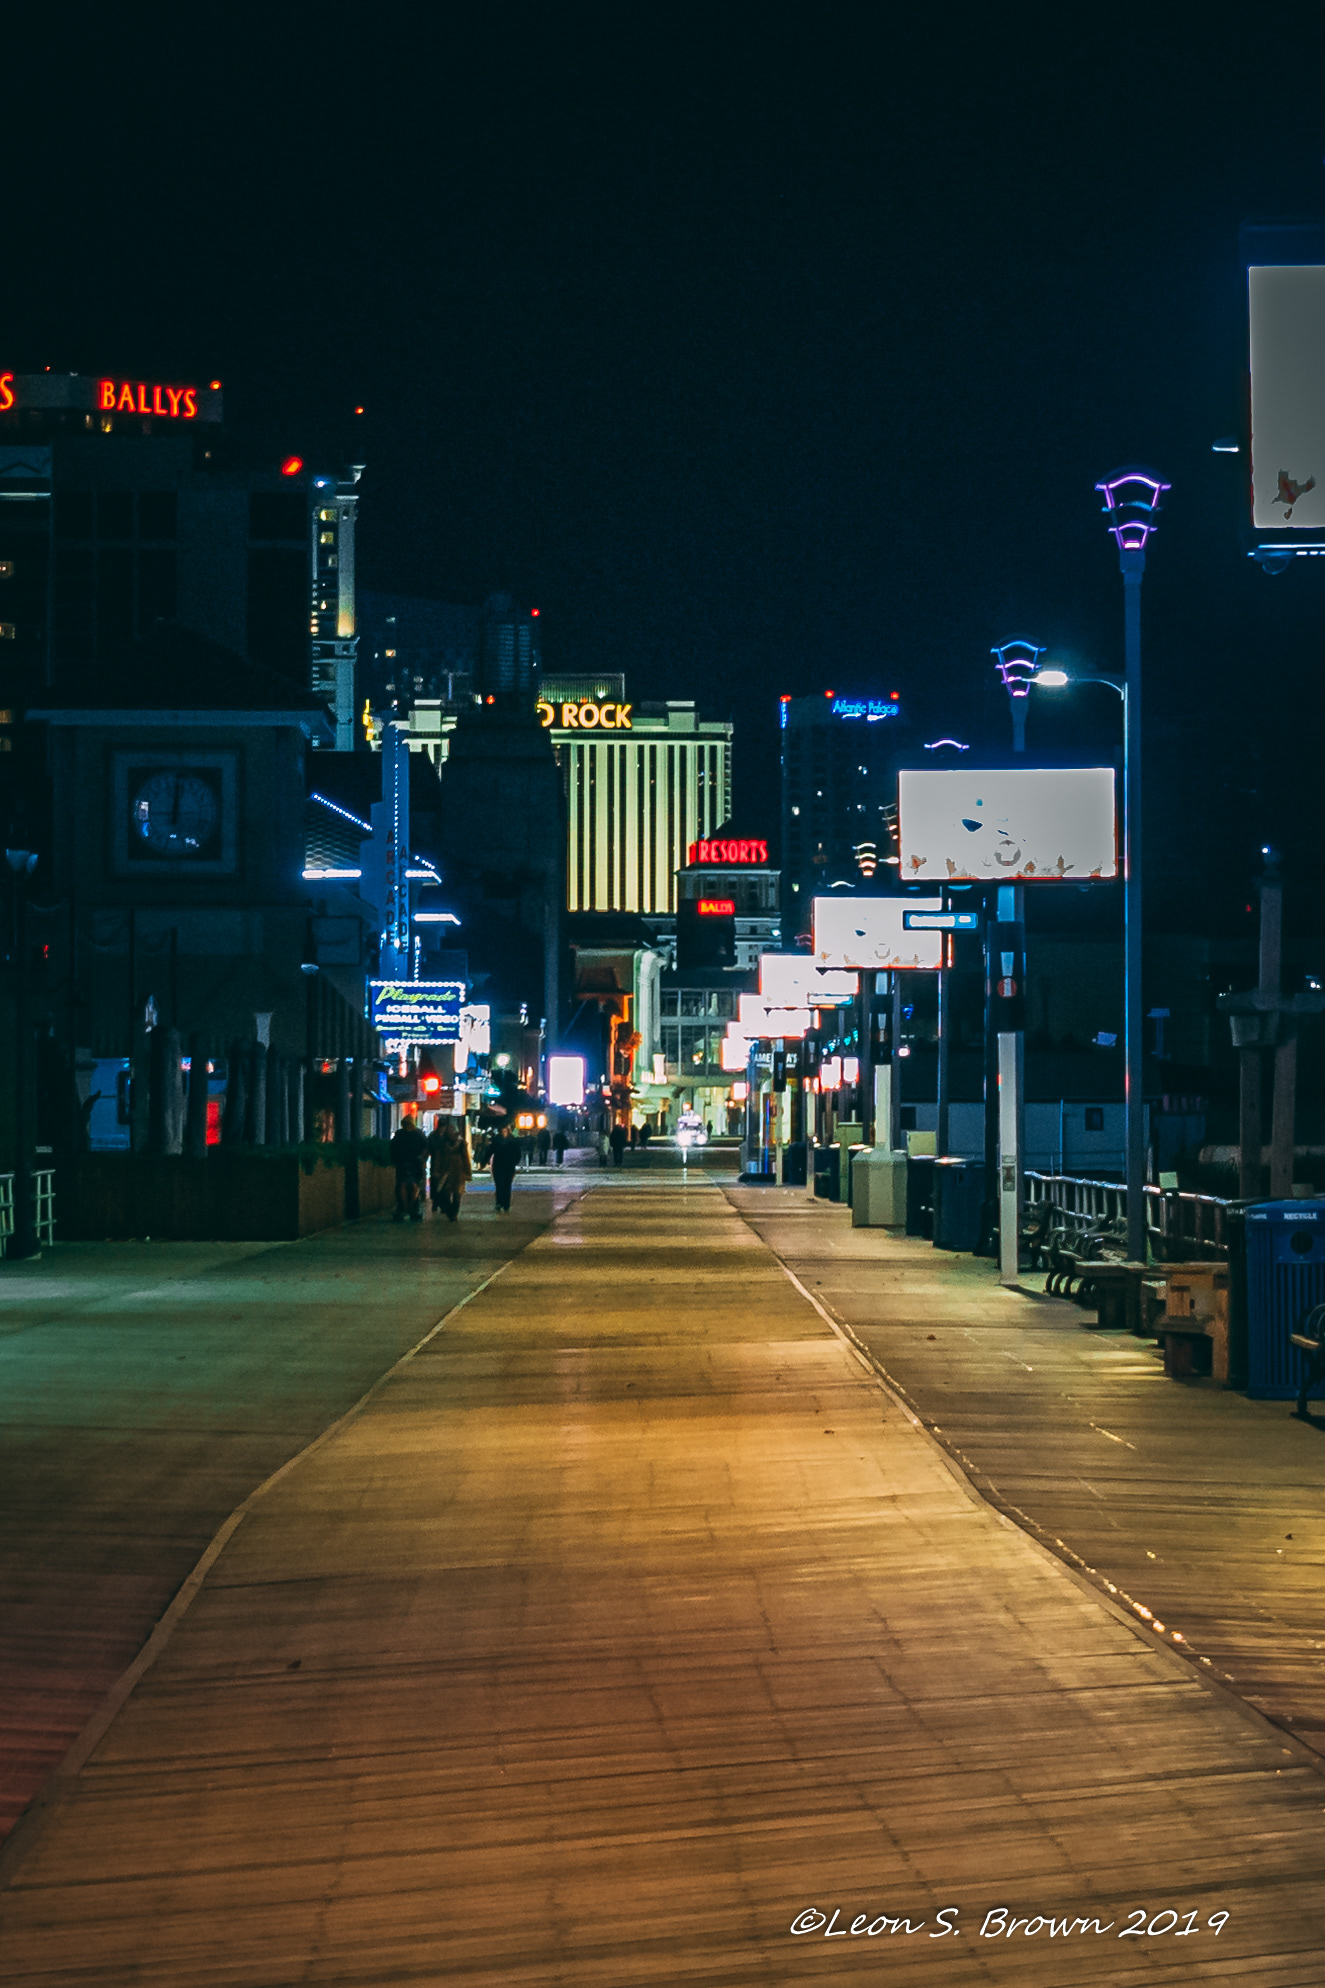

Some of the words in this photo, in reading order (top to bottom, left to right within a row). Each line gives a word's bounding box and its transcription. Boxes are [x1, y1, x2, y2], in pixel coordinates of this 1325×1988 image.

[99, 380, 197, 418] BALLYS
[562, 703, 632, 729] ROCK
[698, 839, 769, 864] RESORTS
[385, 830, 395, 946] ARCADE
